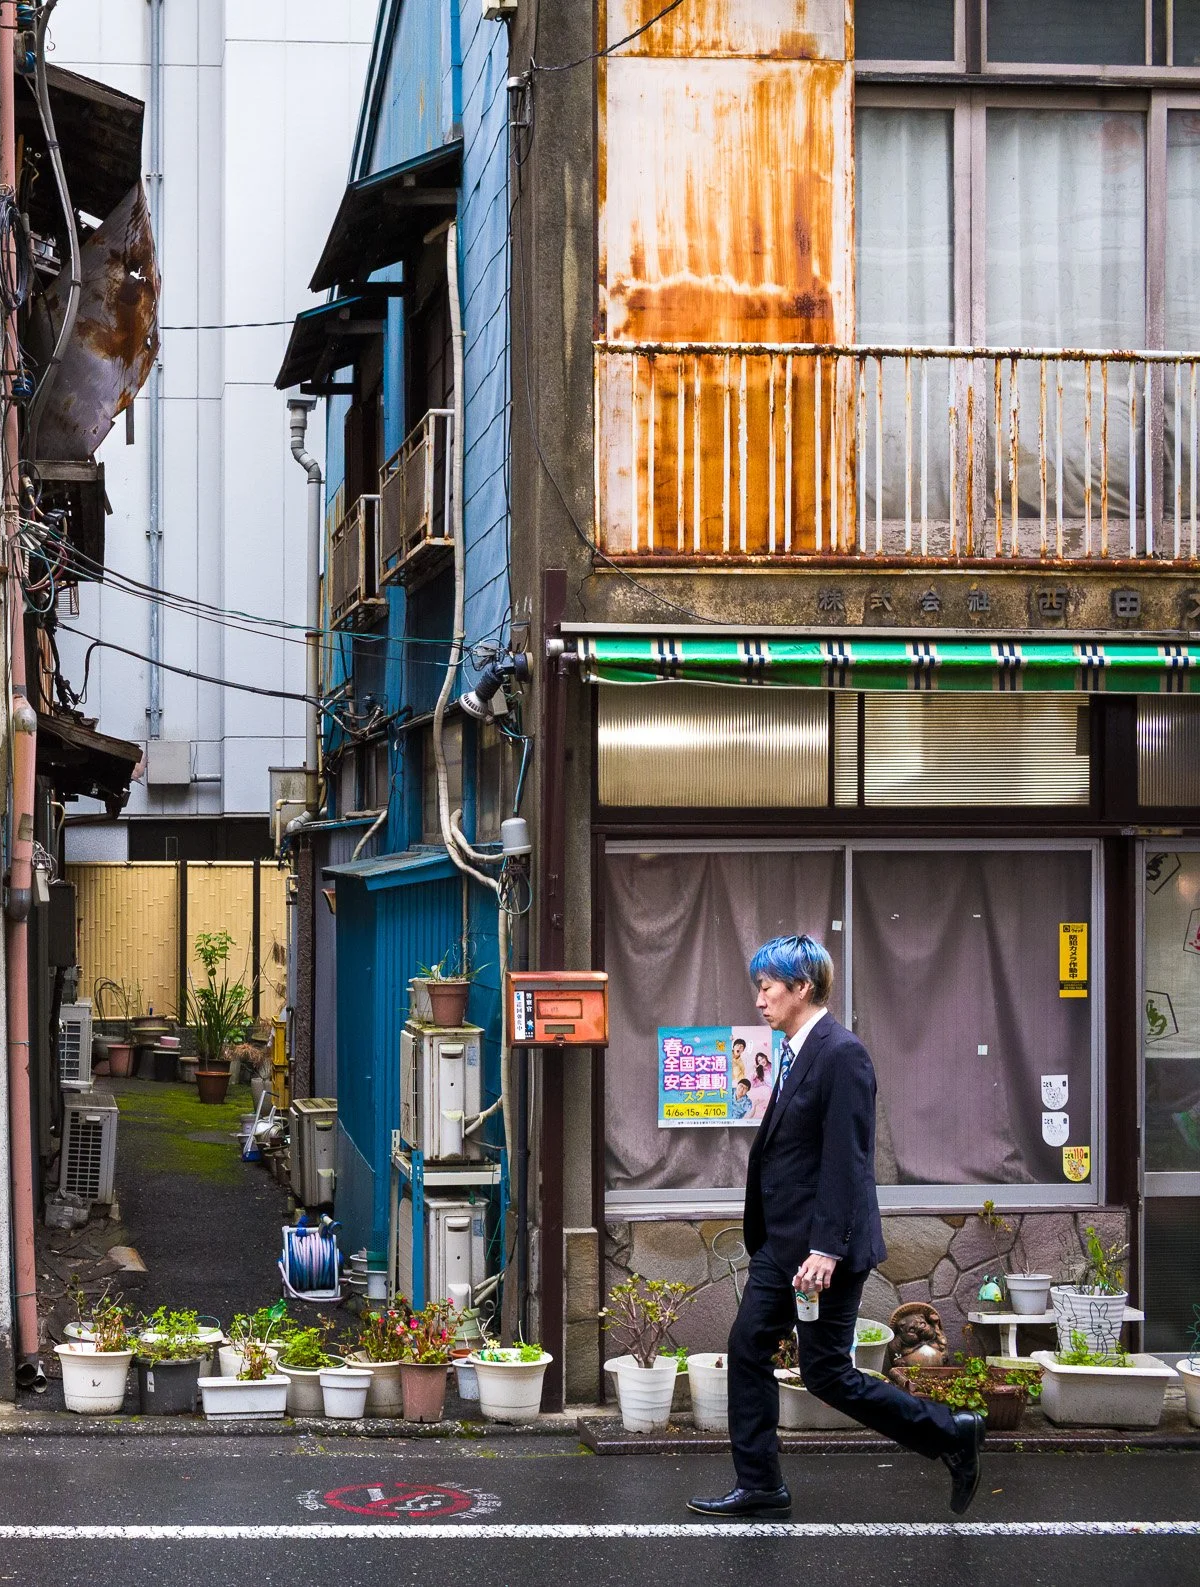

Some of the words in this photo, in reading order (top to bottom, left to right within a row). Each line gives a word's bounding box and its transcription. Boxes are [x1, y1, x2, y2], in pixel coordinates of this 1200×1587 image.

[663, 1038, 693, 1057] 春の
[663, 1055, 727, 1073] 全国交通
[664, 1073, 727, 1091] 安全運動
[683, 1088, 728, 1102] スタート
